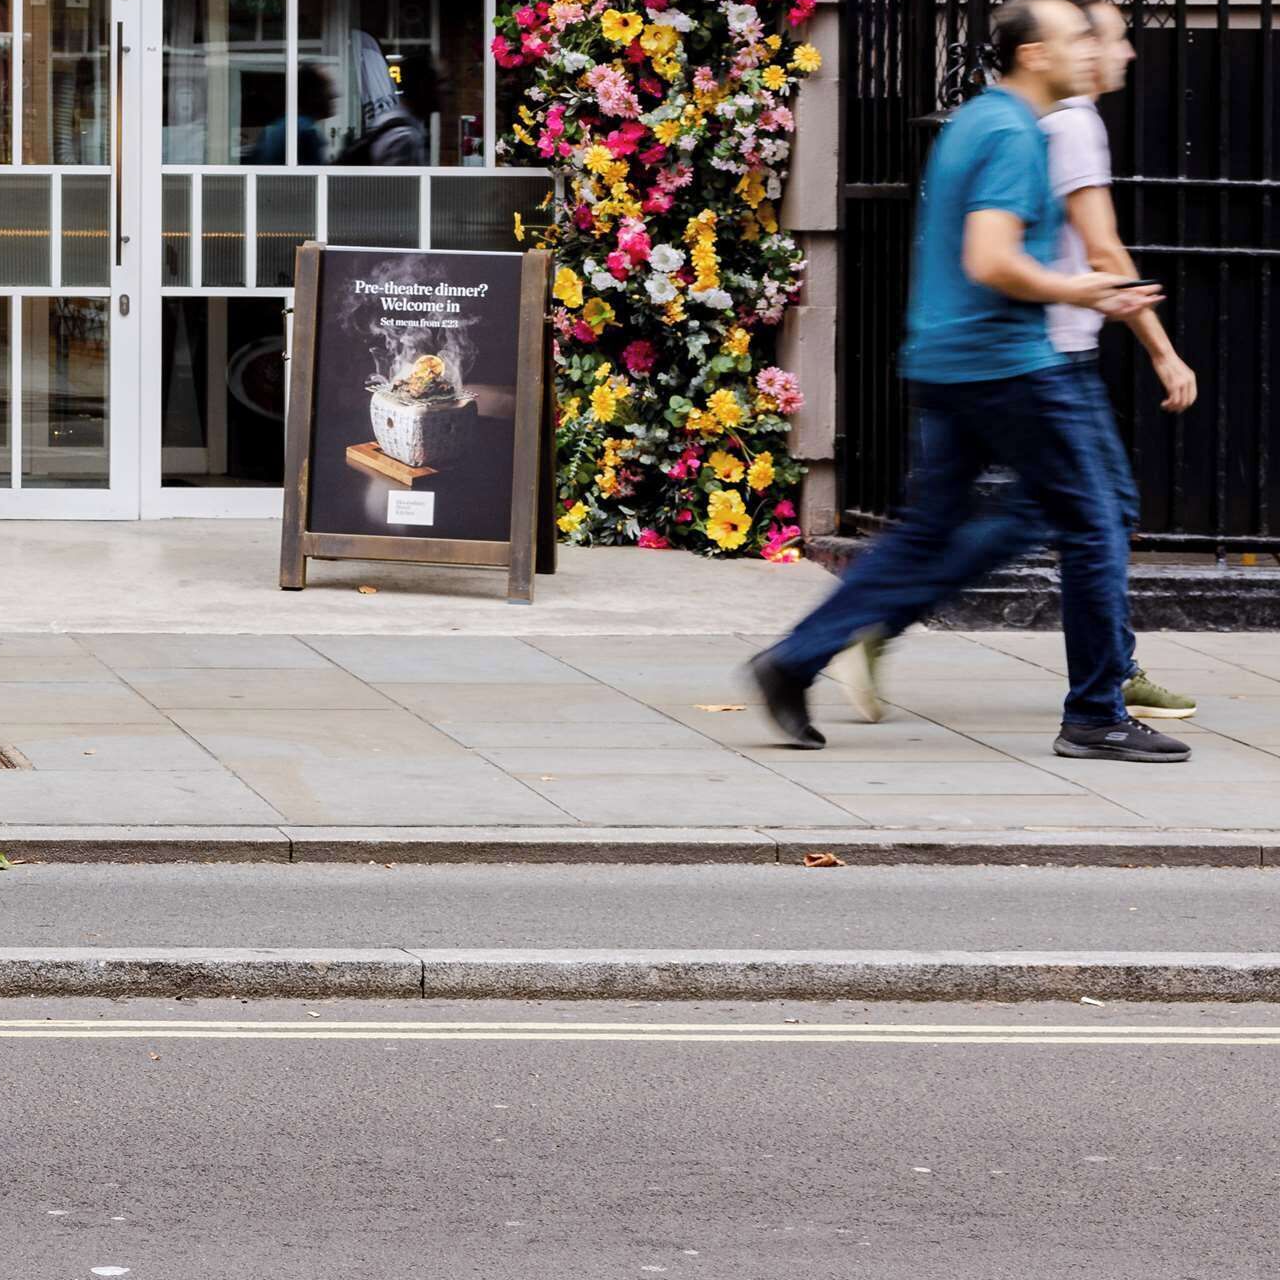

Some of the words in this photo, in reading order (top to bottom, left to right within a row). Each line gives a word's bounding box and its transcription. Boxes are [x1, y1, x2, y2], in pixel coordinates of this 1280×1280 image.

[354, 279, 434, 296] Pre-theatre
[435, 282, 489, 298] dinner?
[380, 297, 445, 313] Welcome
[446, 300, 461, 313] in
[380, 317, 394, 327] Set
[396, 319, 419, 328] menu
[420, 318, 440, 328] from
